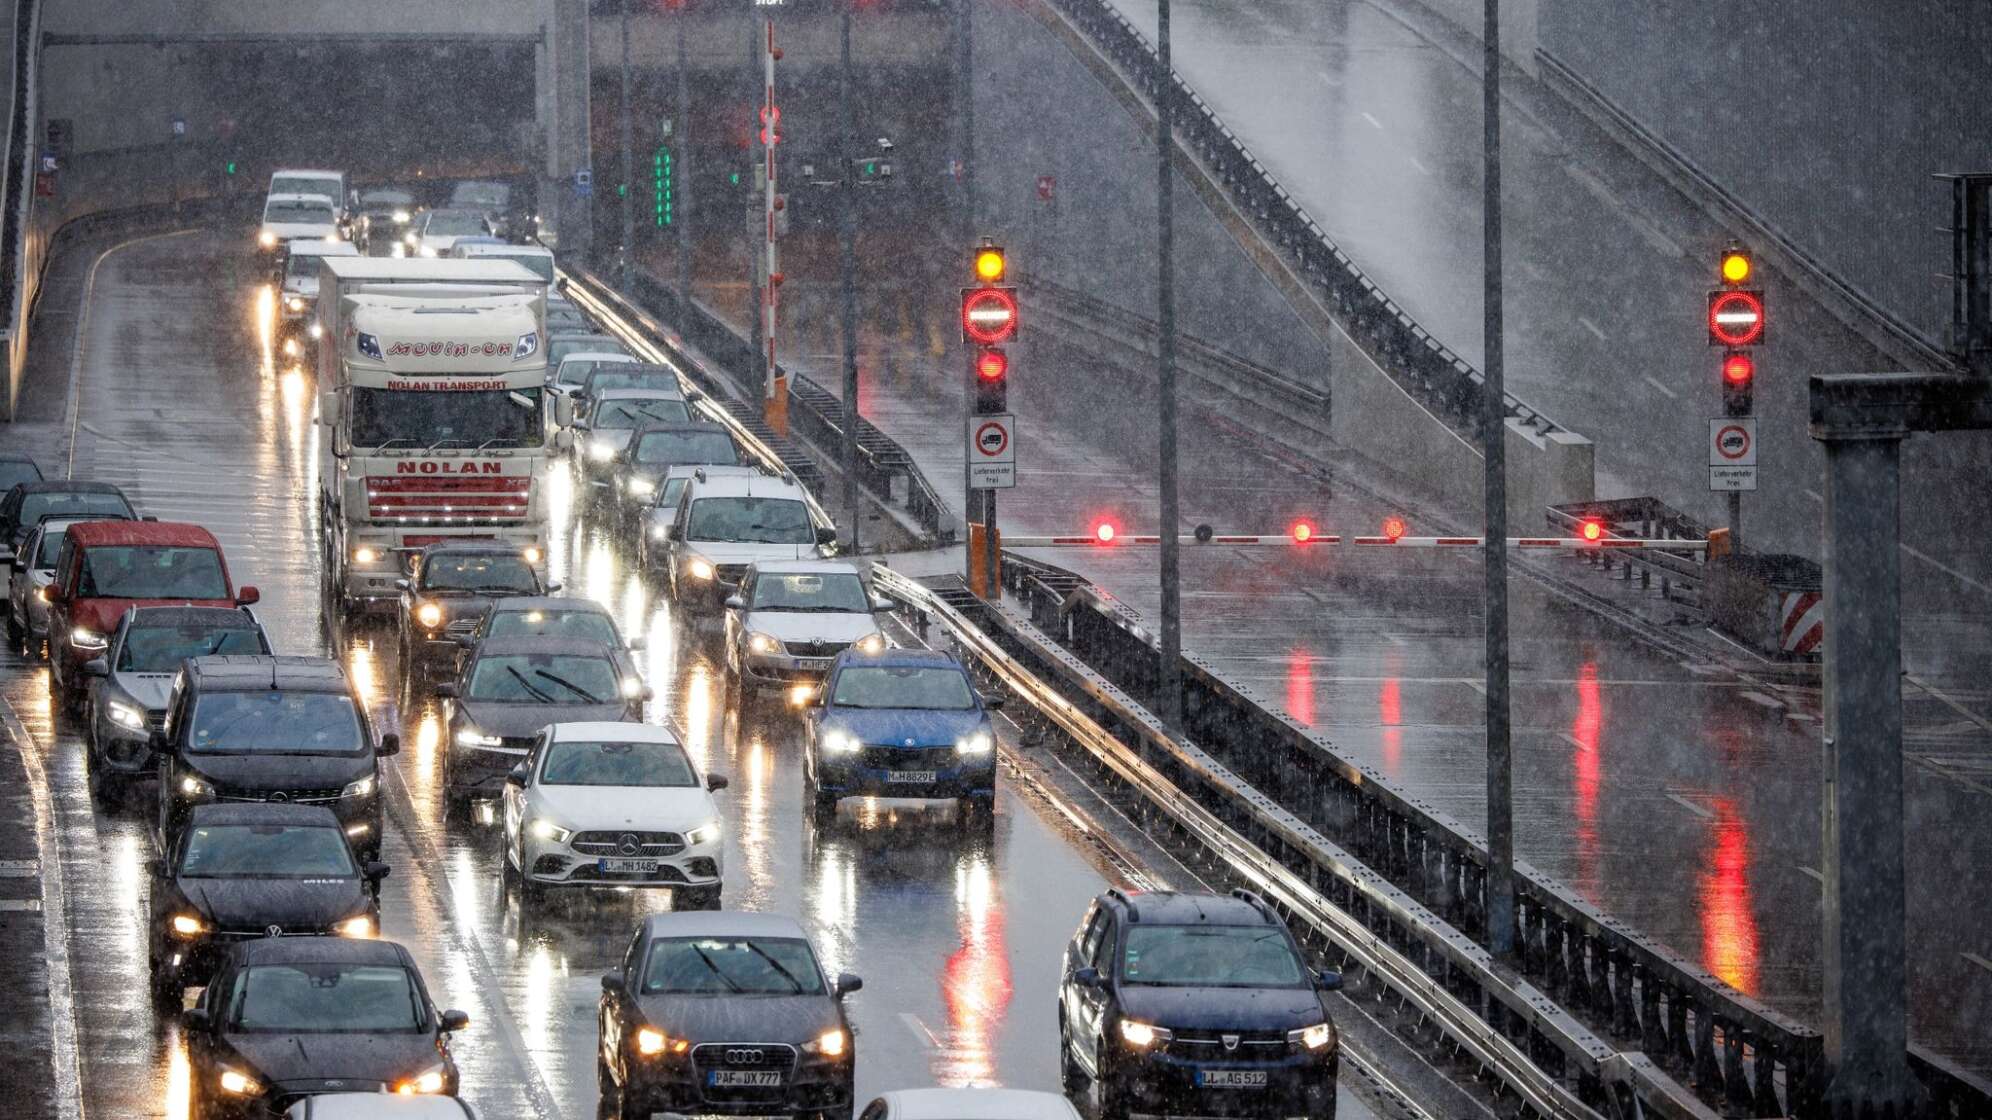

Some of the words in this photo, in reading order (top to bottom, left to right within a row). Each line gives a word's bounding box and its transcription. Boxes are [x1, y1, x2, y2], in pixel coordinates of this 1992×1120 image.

[388, 381, 429, 391] NOLAN
[432, 381, 507, 391] TRANSPORT
[397, 462, 502, 474] NOLAN
[716, 1072, 736, 1084] PAF
[760, 1072, 778, 1085] 777
[1244, 1073, 1266, 1085] 512
